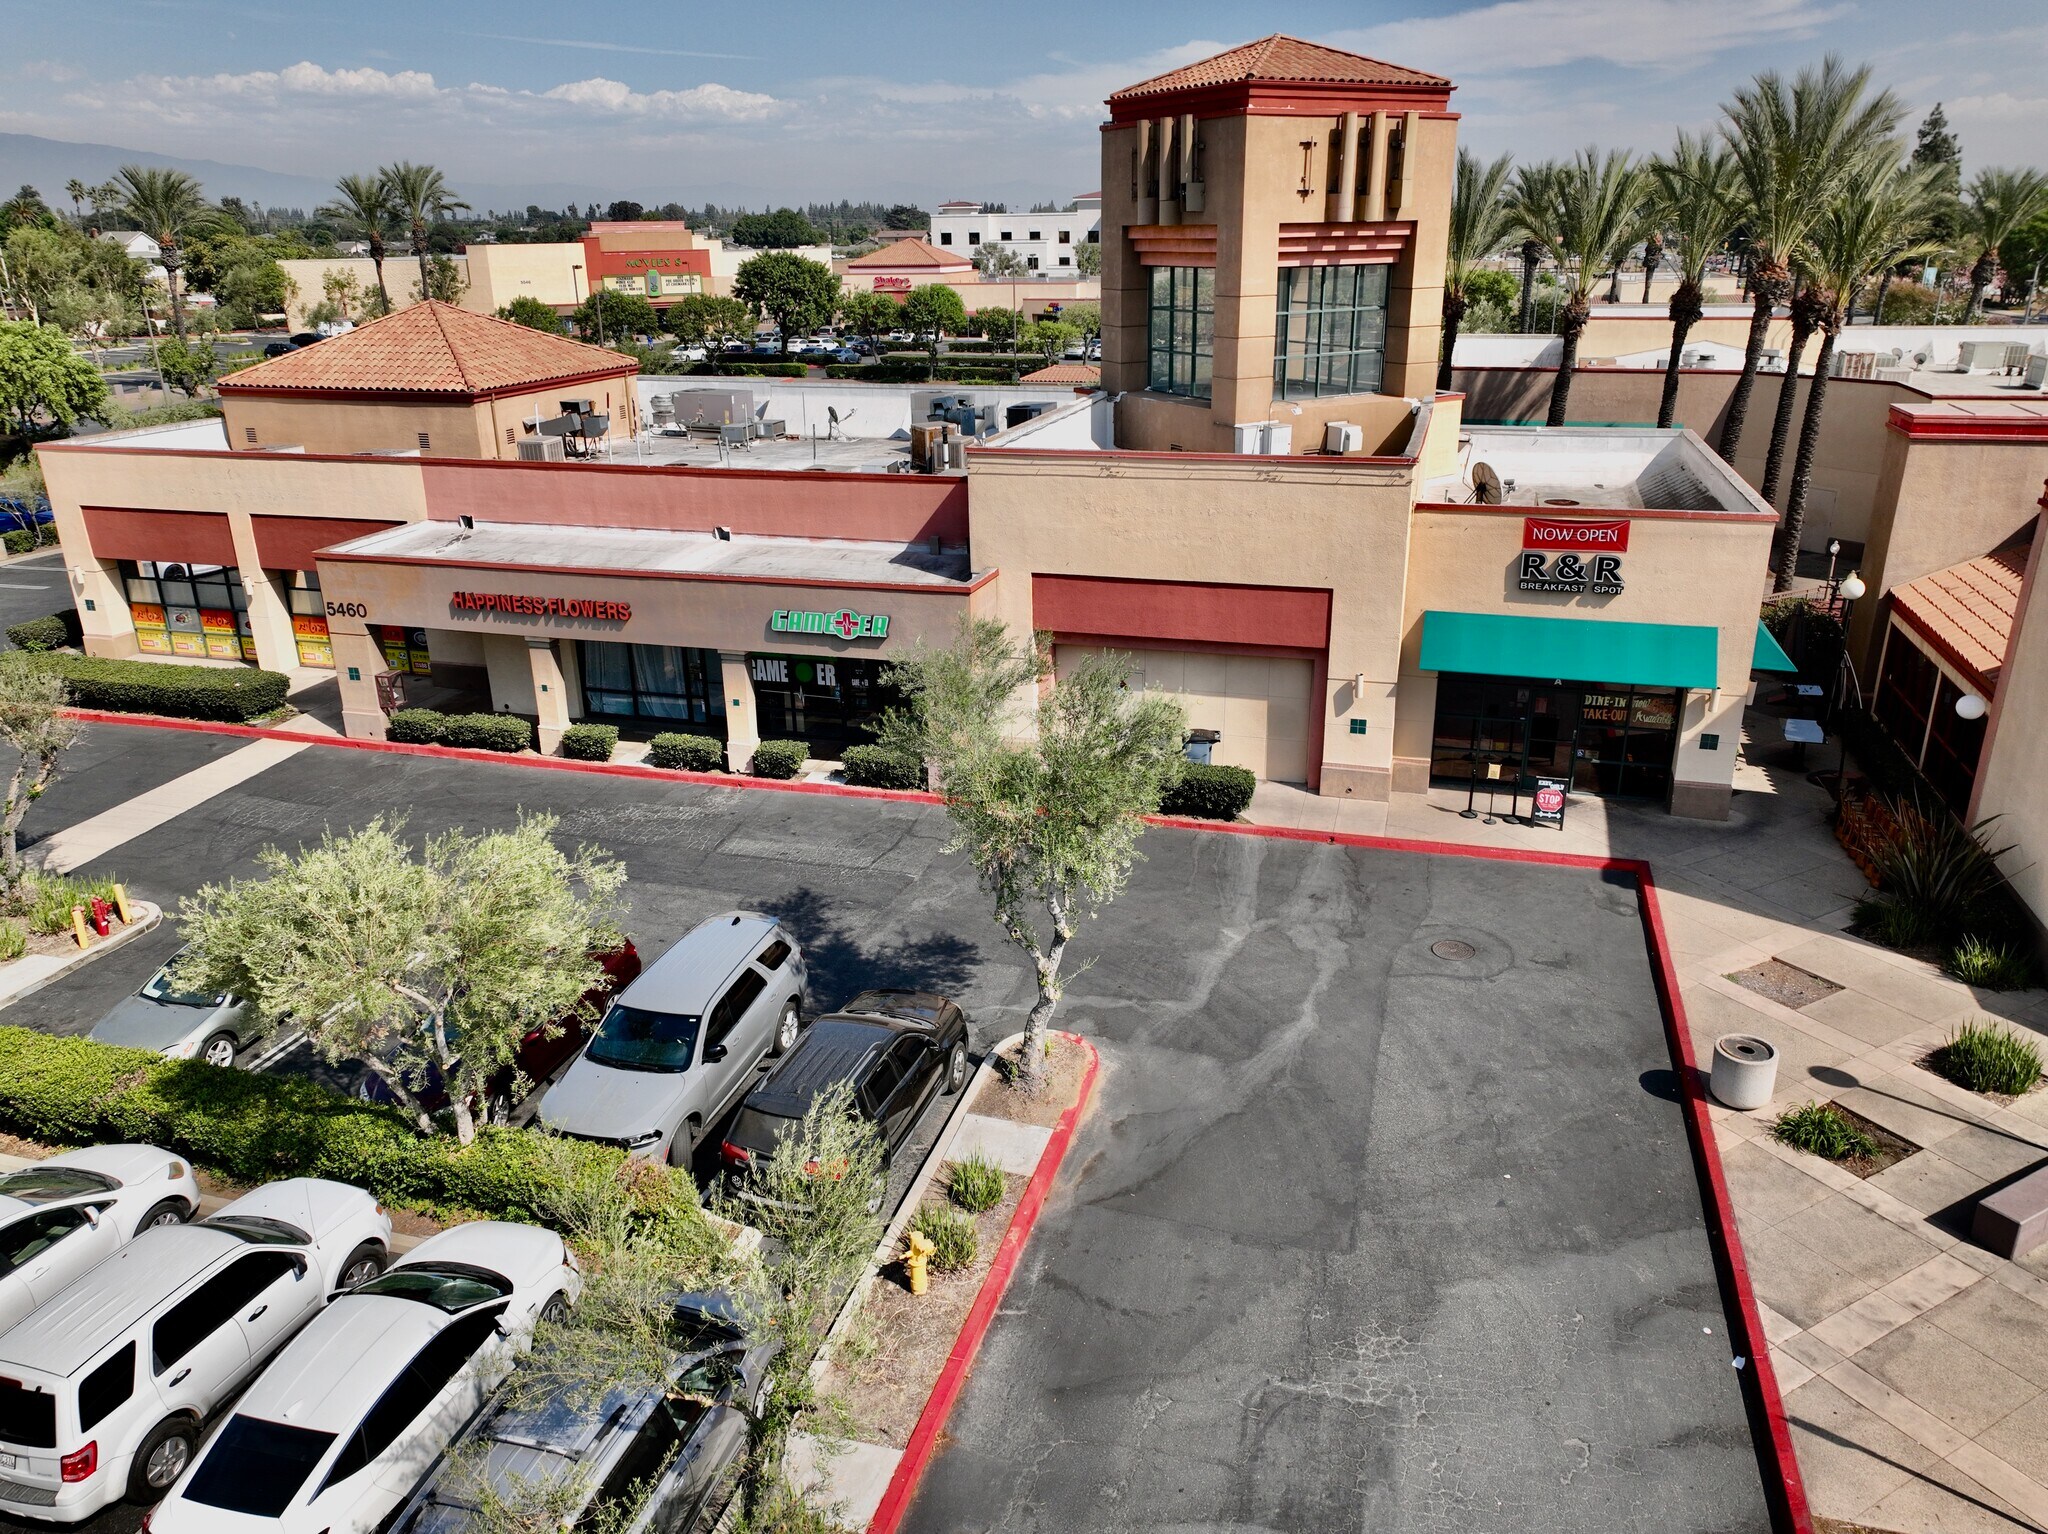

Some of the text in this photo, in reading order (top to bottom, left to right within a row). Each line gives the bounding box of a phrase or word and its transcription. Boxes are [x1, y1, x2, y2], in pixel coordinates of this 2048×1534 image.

[626, 258, 671, 268] MOVIES
[1532, 527, 1618, 542] NOW OPEN
[1519, 552, 1625, 583] R & R
[1519, 581, 1624, 594] BREAKFAST SPOT
[326, 601, 368, 618] 5460
[452, 591, 632, 621] HAPPINESS FLOWERS
[816, 663, 837, 687] ER
[1554, 678, 1563, 686] A
[1584, 694, 1627, 708] DINE-IN
[1583, 708, 1628, 721] TAKE-OUT
[1538, 793, 1561, 805] STOP
